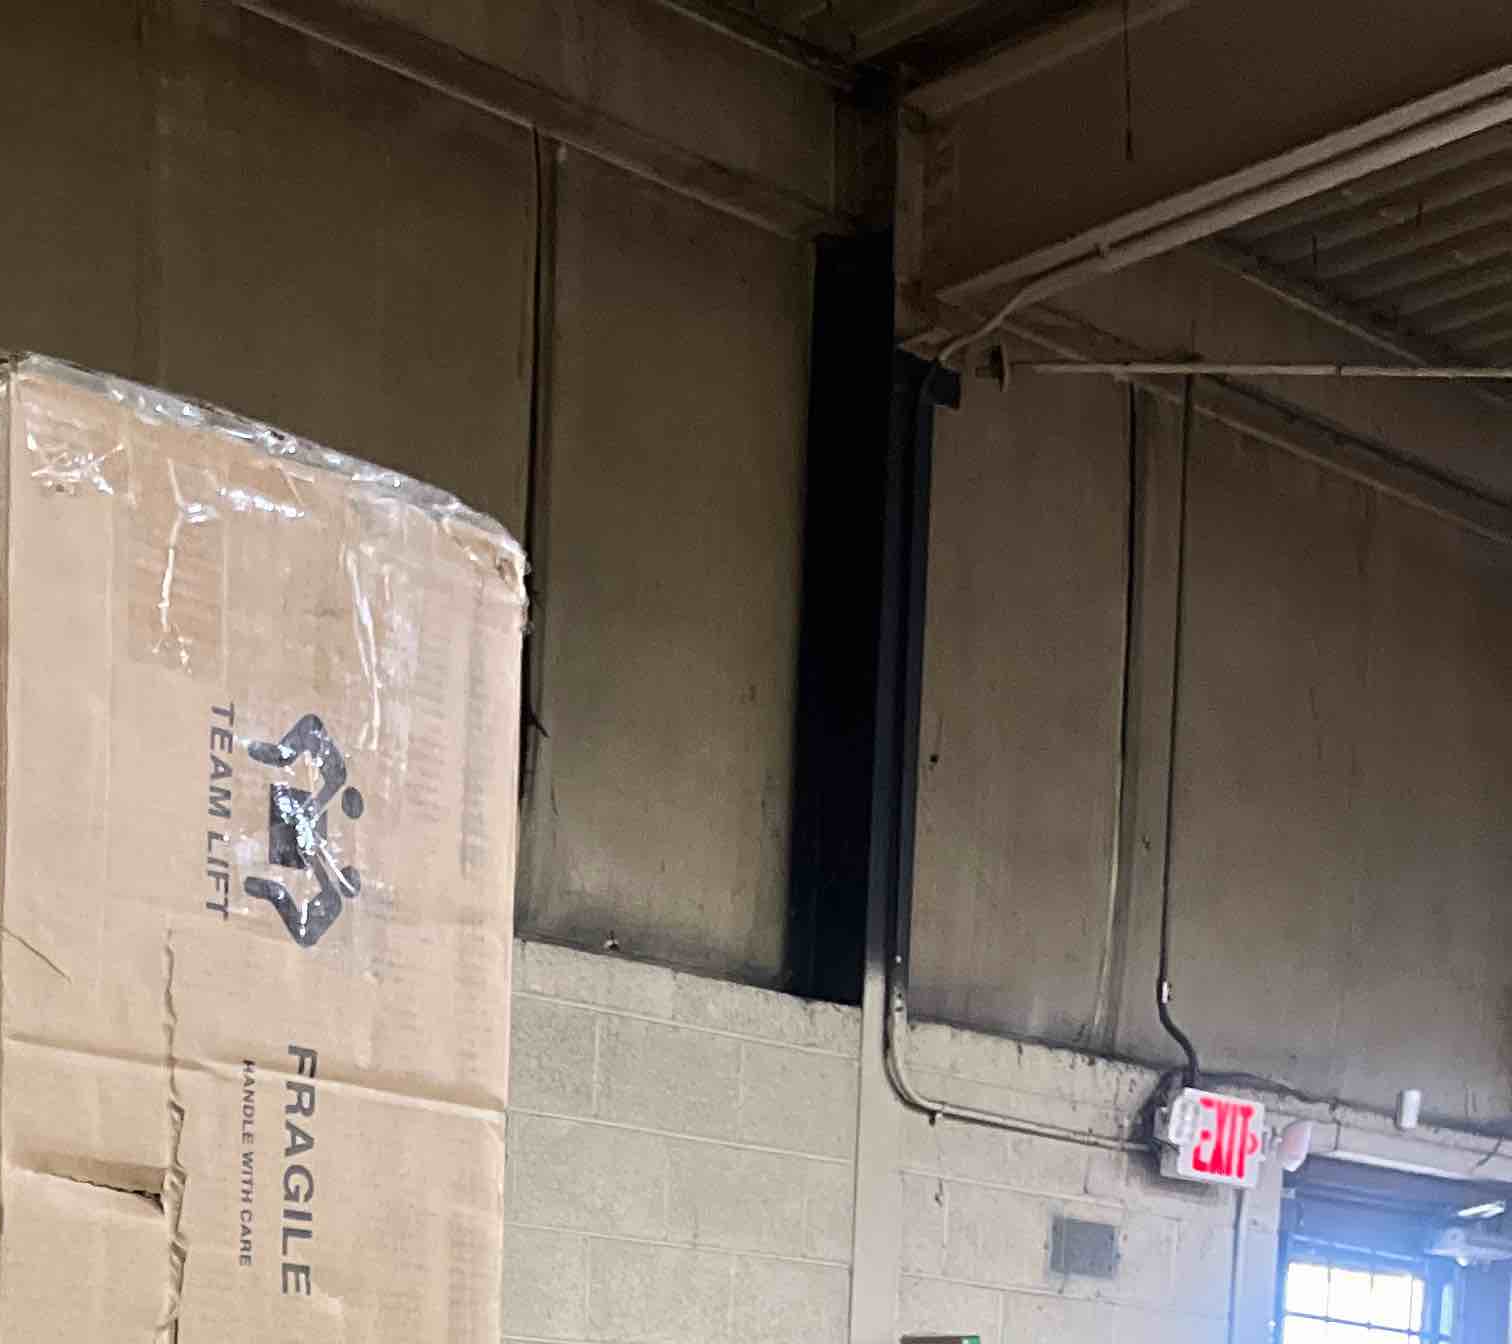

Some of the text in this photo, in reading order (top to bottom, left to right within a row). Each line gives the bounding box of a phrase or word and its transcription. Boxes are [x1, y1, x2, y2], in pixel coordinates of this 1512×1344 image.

[203, 703, 235, 920] TEAM LIFT
[238, 1060, 256, 1268] HANDLE WITH CARE
[281, 1044, 318, 1297] FRAGILE
[1192, 1097, 1254, 1178] EXIT
